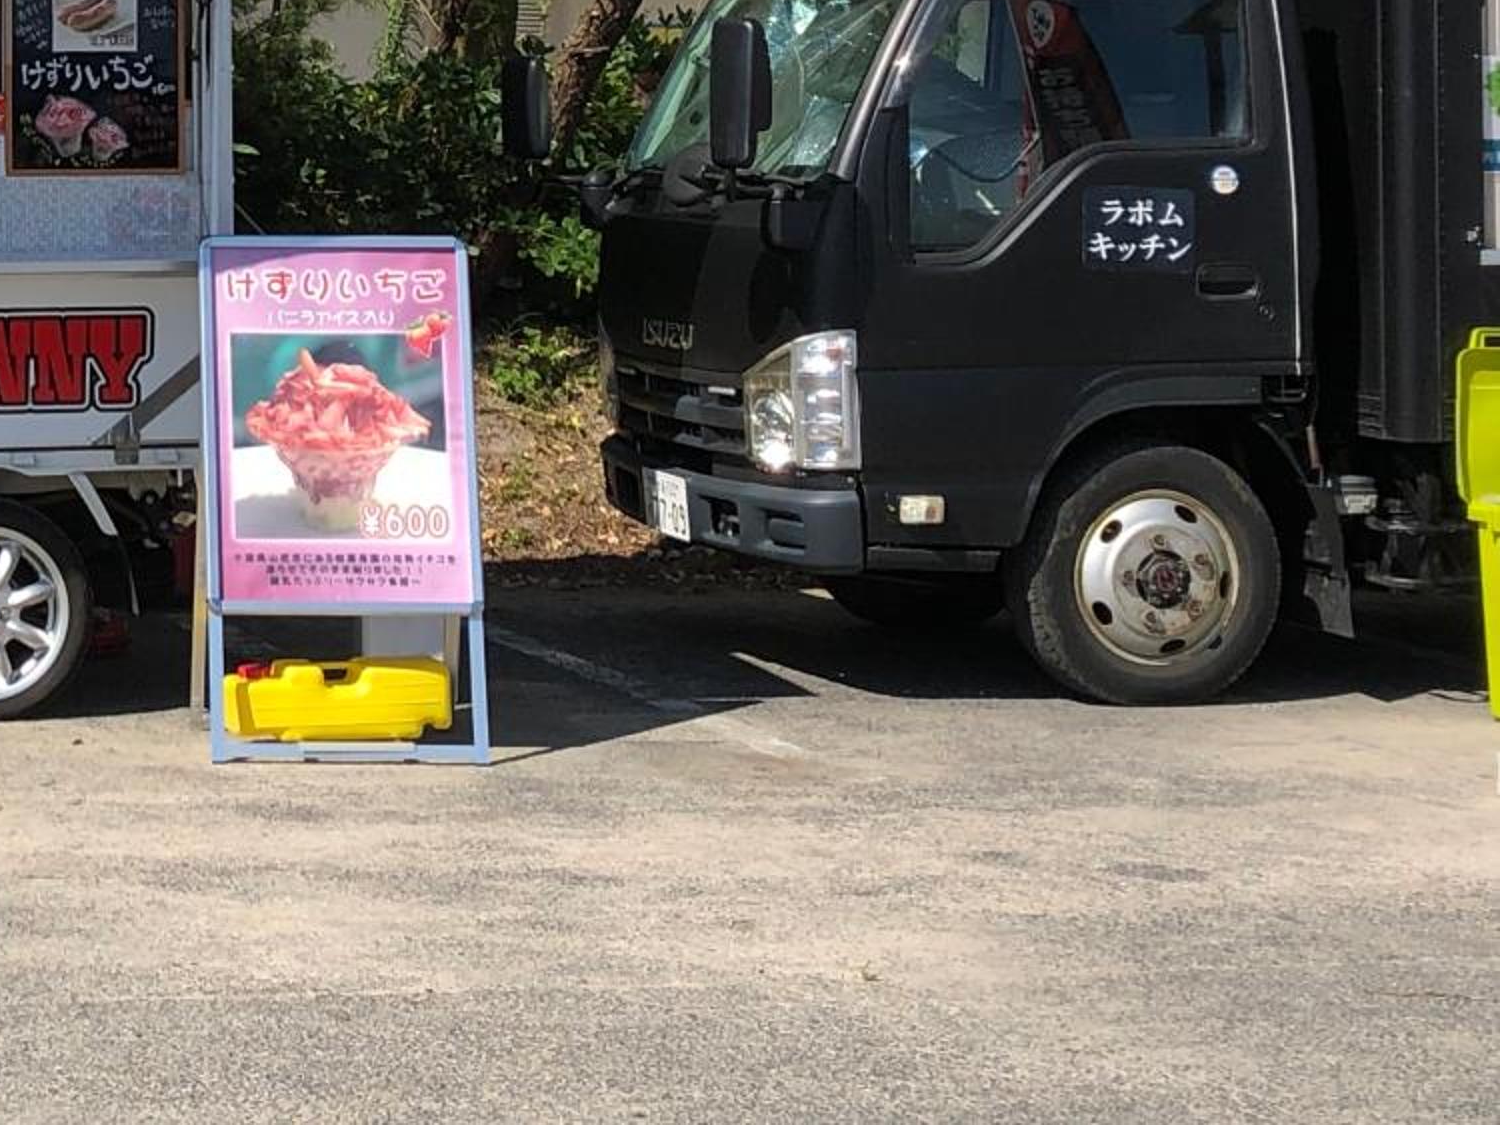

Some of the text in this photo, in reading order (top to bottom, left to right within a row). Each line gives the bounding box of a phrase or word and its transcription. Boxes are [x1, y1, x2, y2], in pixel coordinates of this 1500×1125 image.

[20, 54, 155, 92] けずりいちご
[1088, 231, 1193, 263] キッチン
[225, 267, 447, 305] けずりいちご
[360, 504, 451, 538] ¥600
